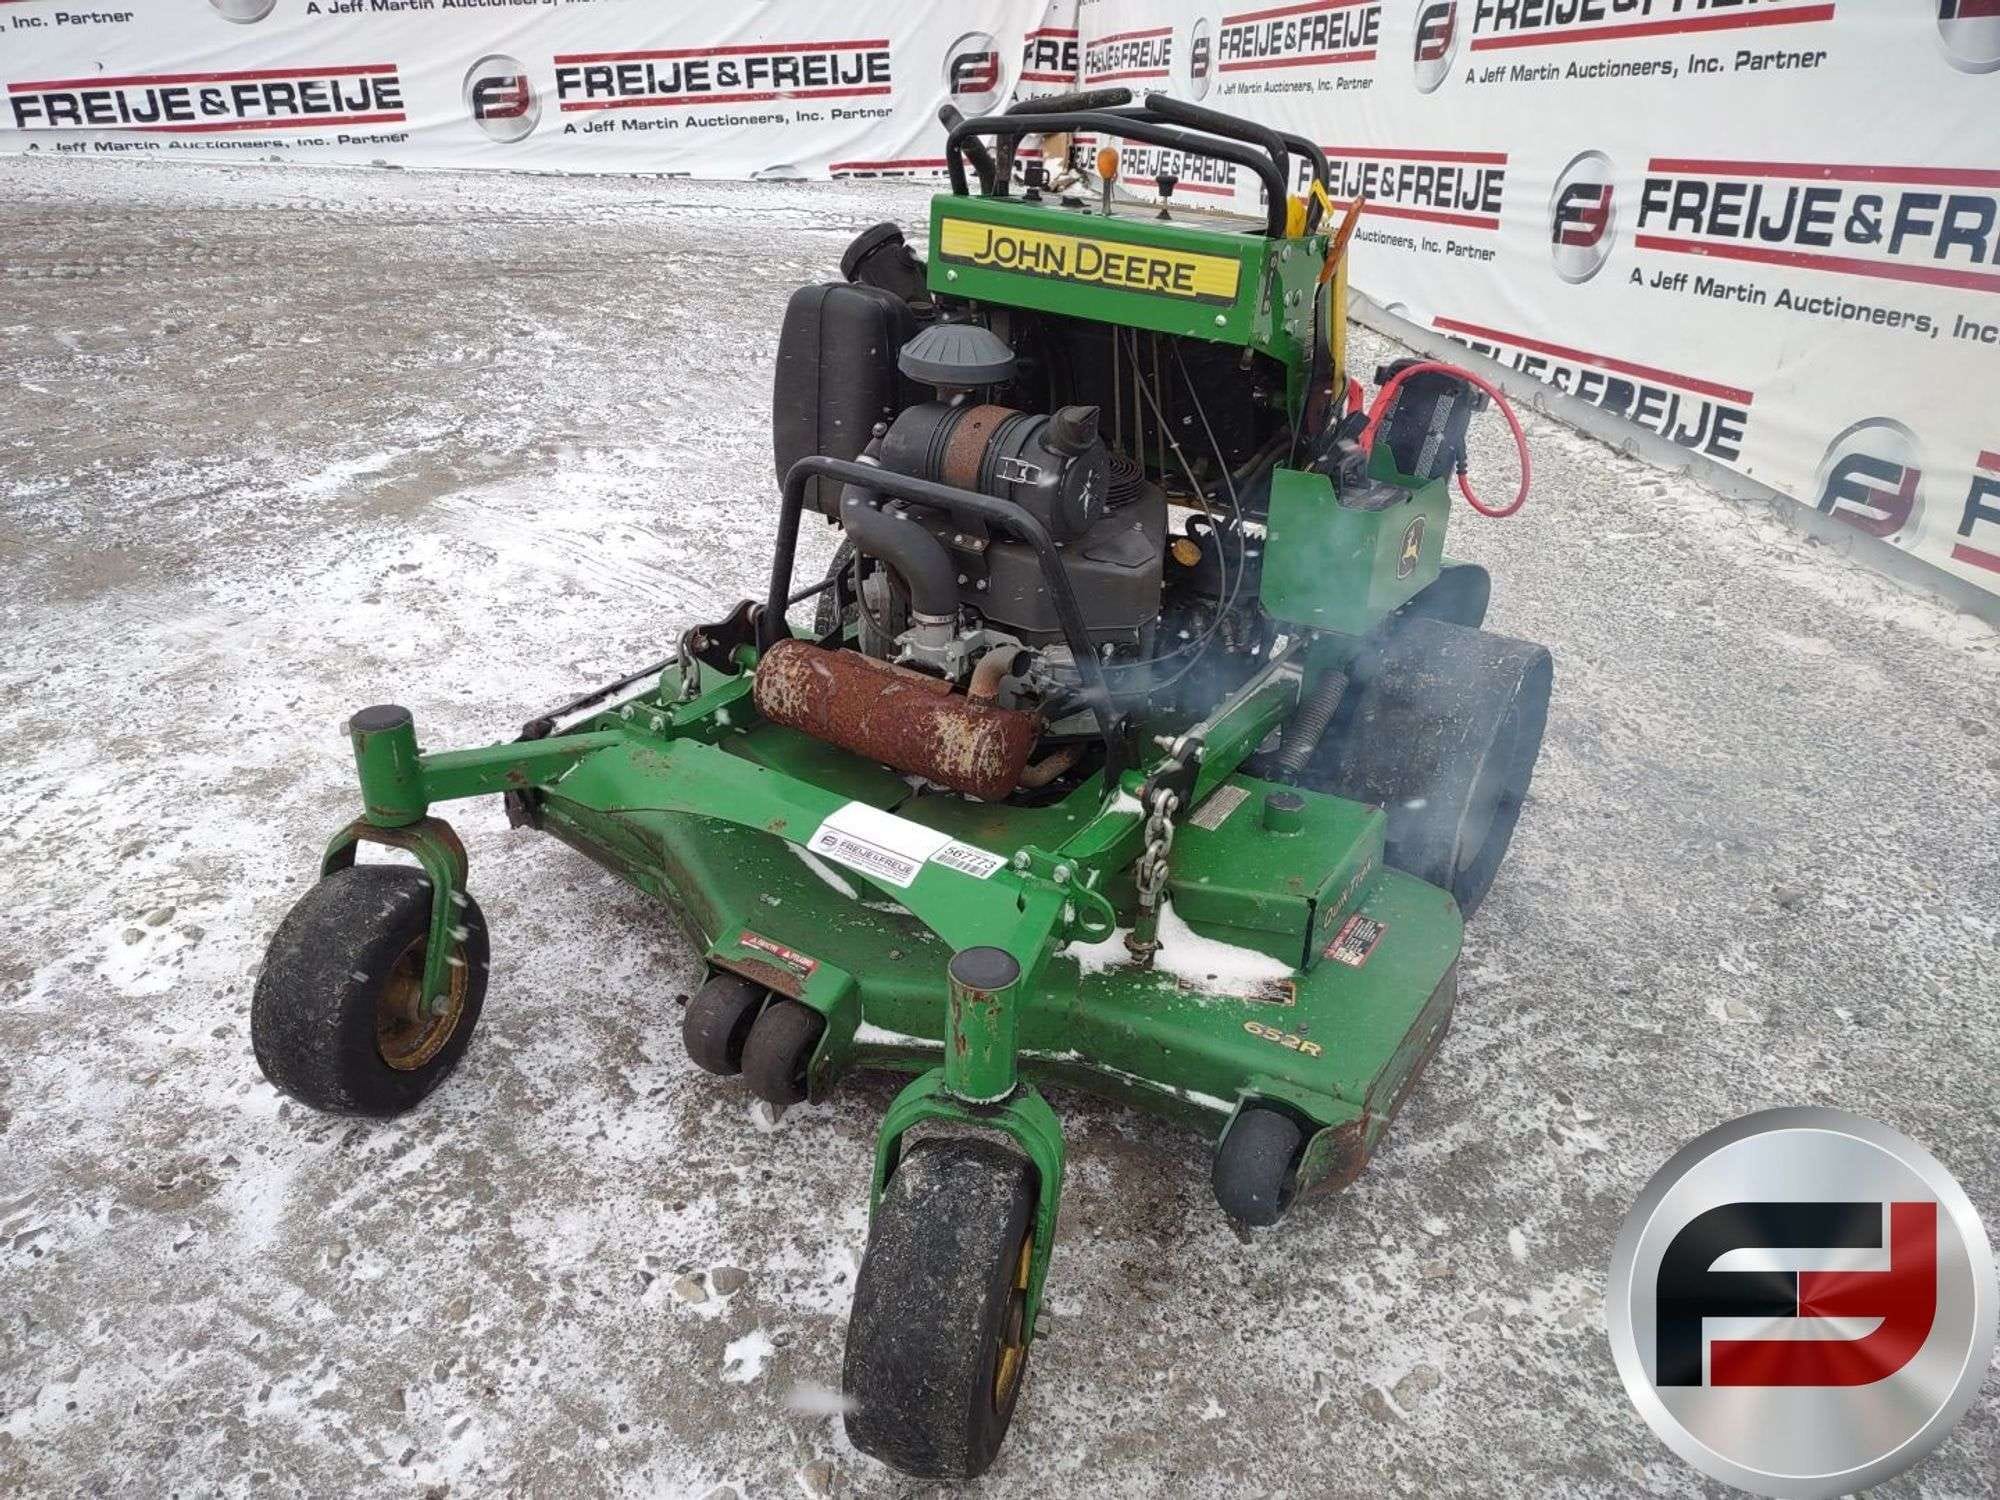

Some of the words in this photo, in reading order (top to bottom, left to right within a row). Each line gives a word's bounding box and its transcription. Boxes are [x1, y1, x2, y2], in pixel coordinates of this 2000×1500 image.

[12, 16, 48, 29] Inc.
[55, 12, 135, 26] Partner
[1465, 68, 1475, 84] A
[1480, 67, 1506, 83] Jeff
[1510, 63, 1560, 82] Martin
[1565, 56, 1679, 80] Auctioneers,
[1688, 53, 1725, 74] Inc.
[1735, 50, 1828, 72] Partner
[1238, 82, 1263, 95] Martin
[1336, 76, 1374, 90] Partner
[564, 122, 577, 134] A
[583, 120, 615, 133] Jeff
[622, 117, 680, 131] Martin
[686, 113, 790, 128] Auctioneers,
[796, 110, 824, 122] Inc.
[831, 106, 893, 120] Partner
[338, 132, 410, 145] Partner
[1354, 226, 1417, 251] Auctioneers,
[1421, 237, 1442, 254] Inc.
[1446, 240, 1496, 262] Partner
[974, 228, 1066, 271] JOHN
[1076, 243, 1196, 292] DEERE
[1629, 267, 1643, 285] A
[1650, 270, 1688, 293] Jeff
[1695, 275, 1767, 305] Martin
[1773, 288, 1939, 339] Auctioneers,
[1953, 314, 2000, 345] Inc
